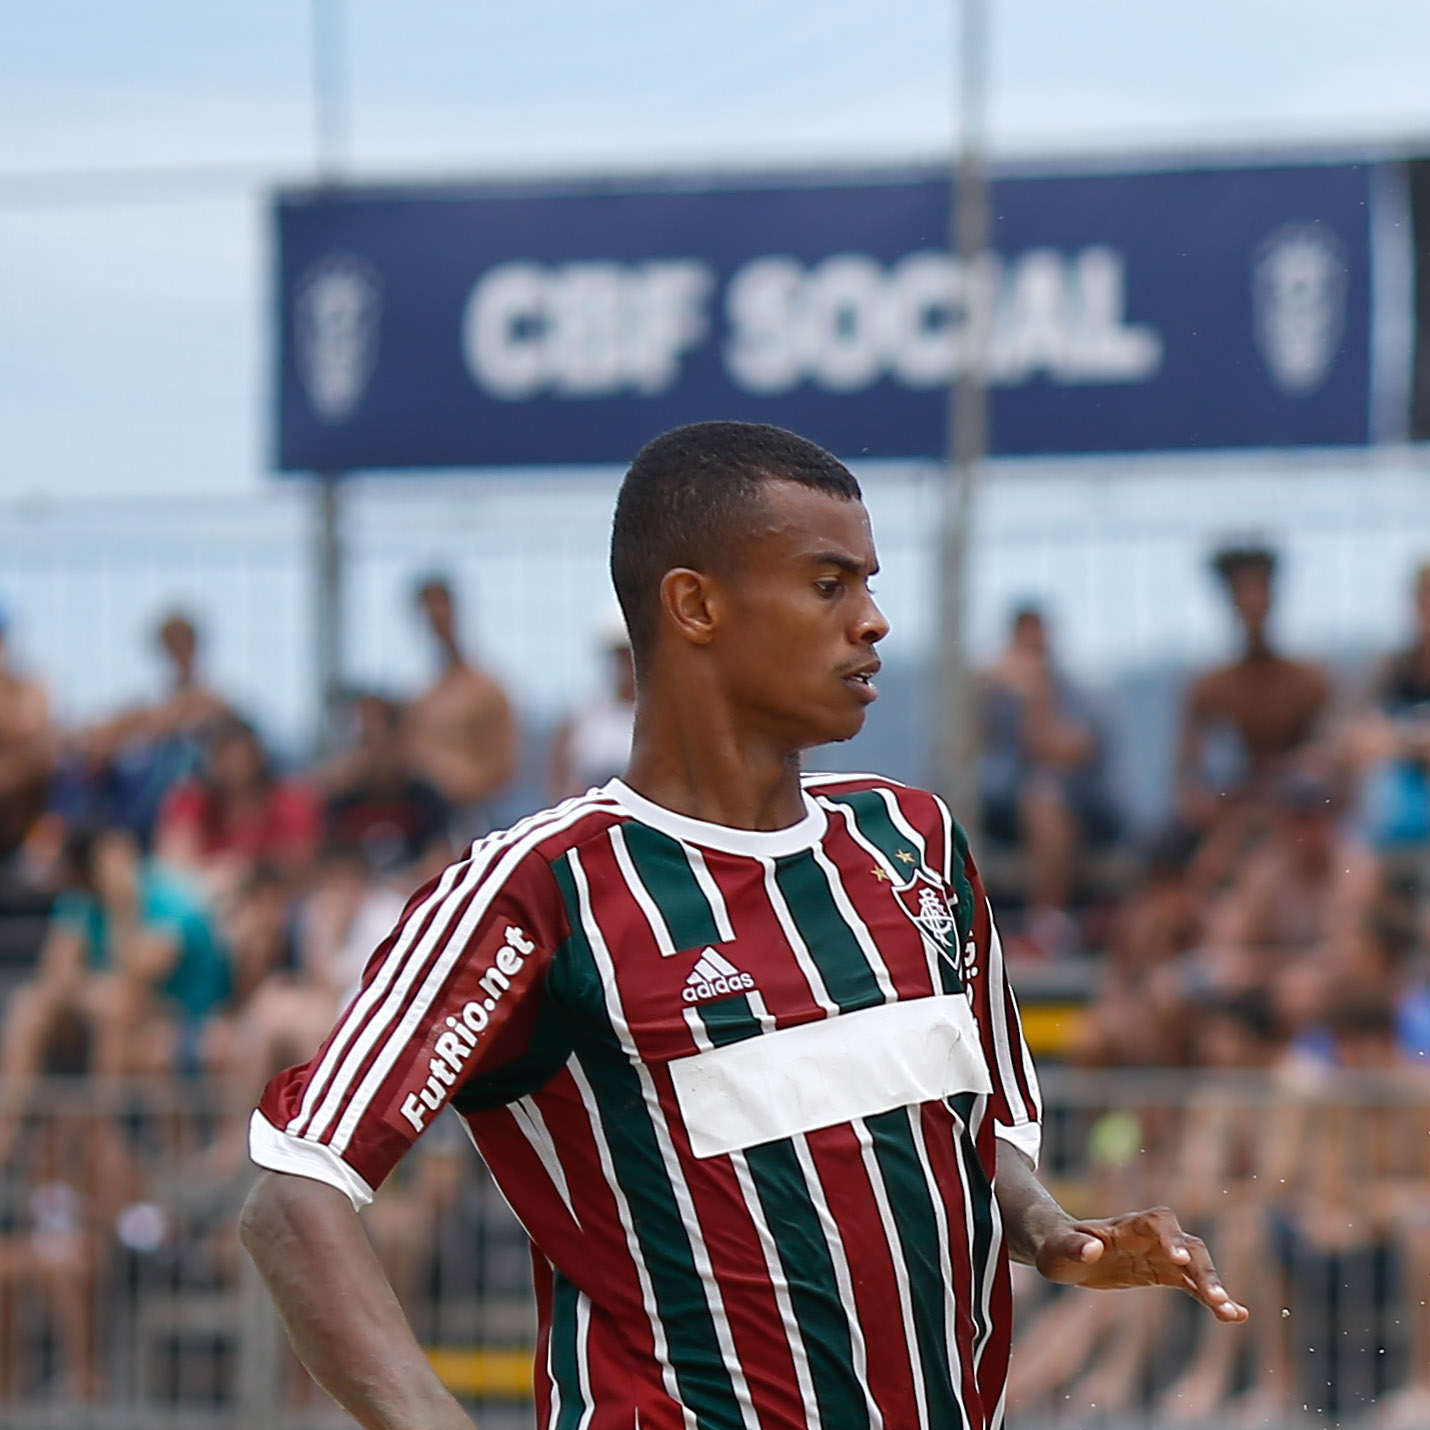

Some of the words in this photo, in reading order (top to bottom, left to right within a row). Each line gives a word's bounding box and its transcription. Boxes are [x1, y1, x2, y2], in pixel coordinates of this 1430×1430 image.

[464, 260, 714, 397] CBF
[400, 925, 536, 1133] FutRio.net
[682, 972, 755, 1002] adidas
